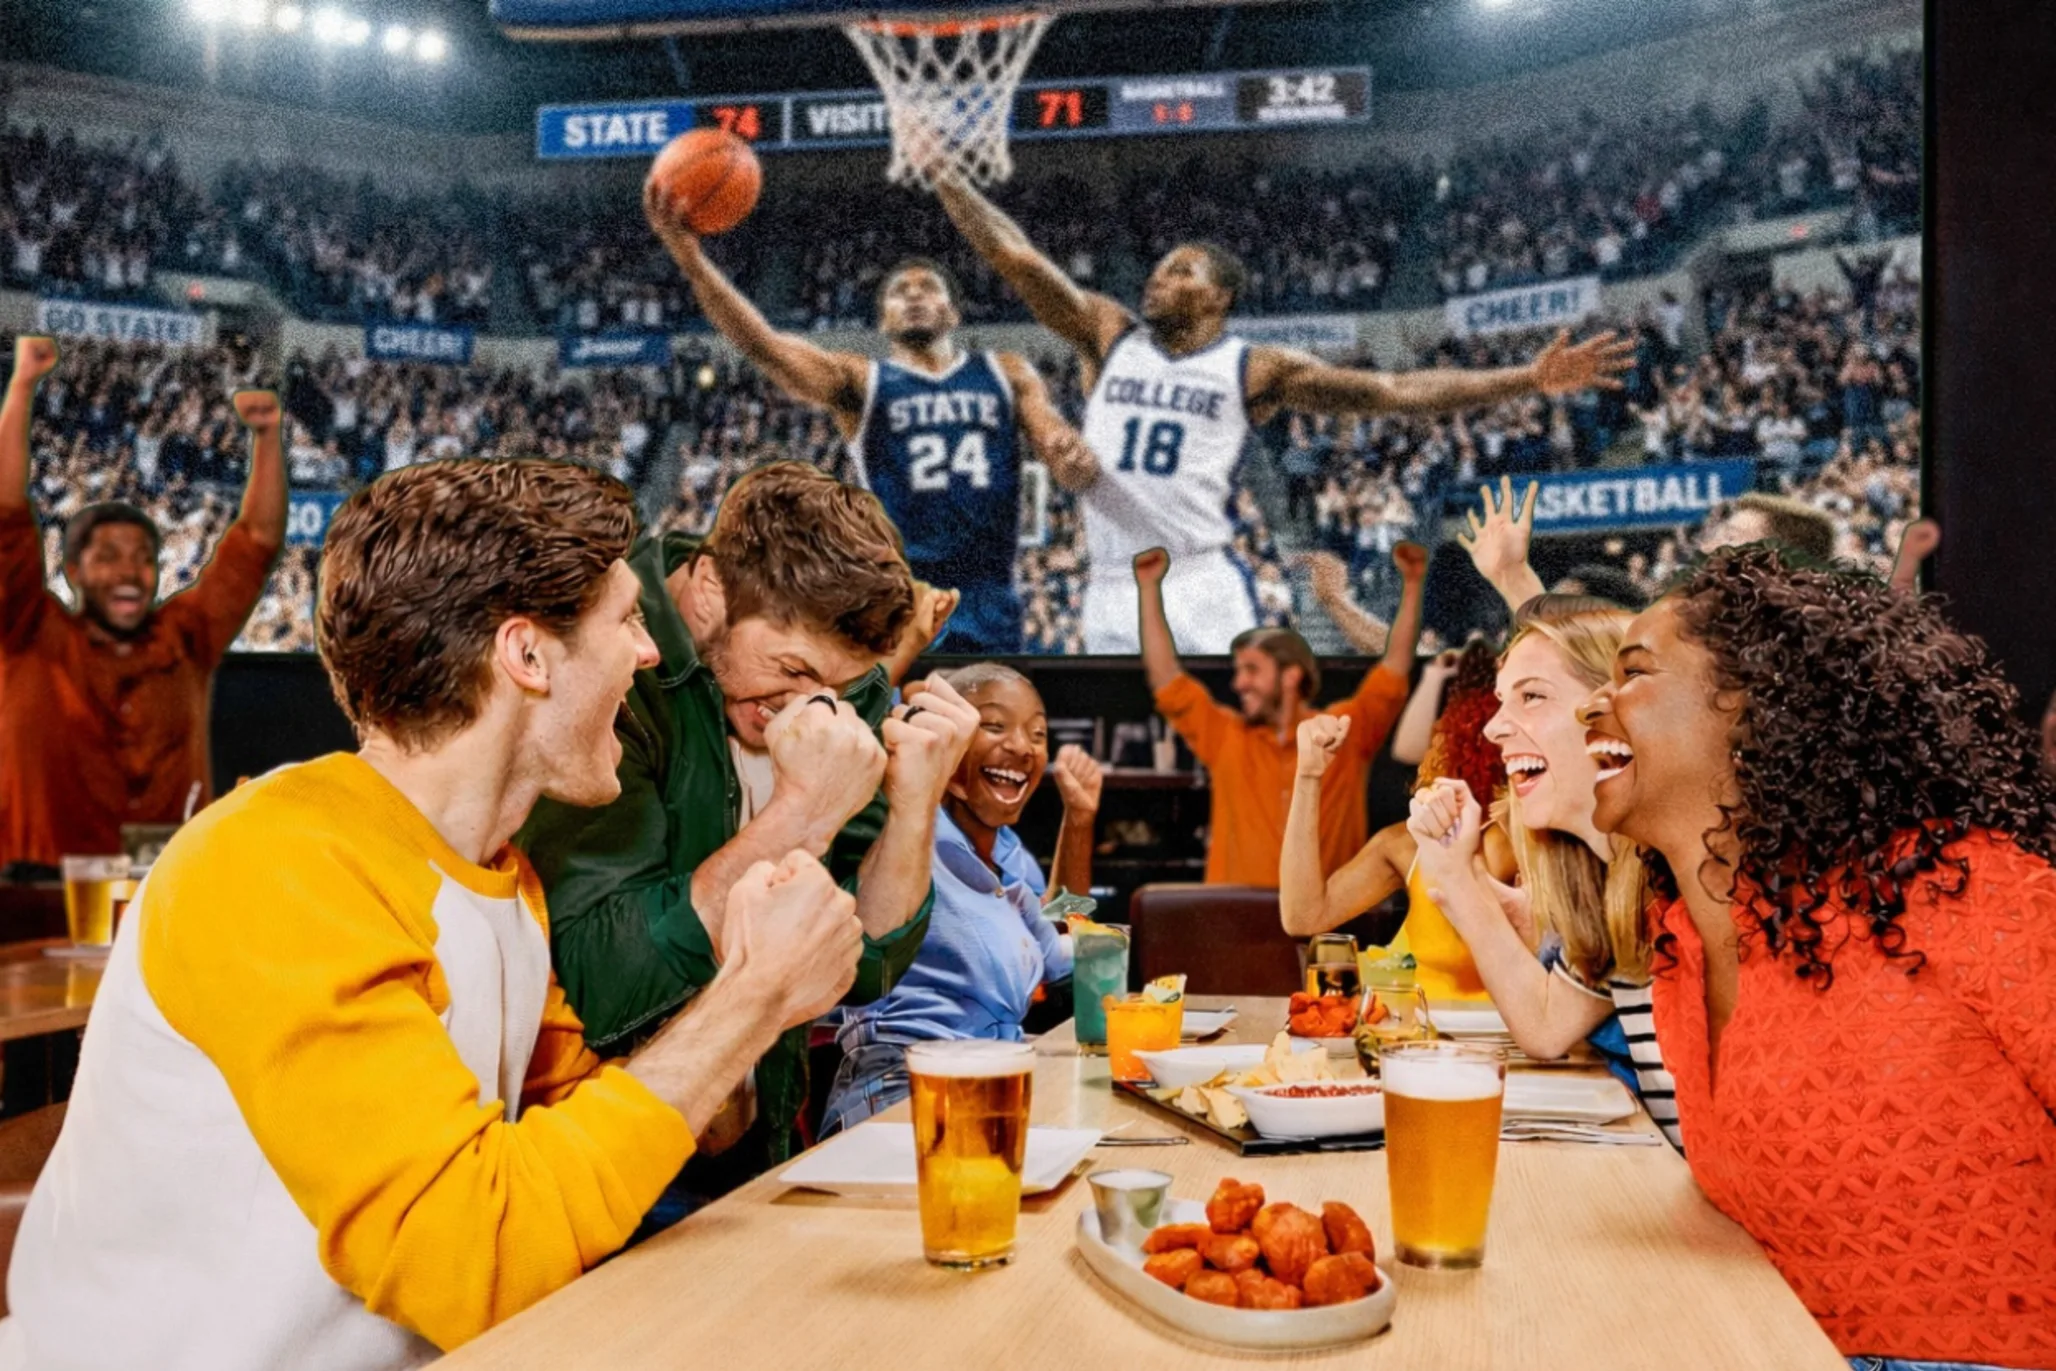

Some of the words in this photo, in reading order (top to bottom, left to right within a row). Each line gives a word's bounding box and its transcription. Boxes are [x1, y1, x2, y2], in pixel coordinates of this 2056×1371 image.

[563, 110, 669, 148] STATE
[1035, 88, 1084, 128] 71
[46, 305, 87, 332] GO
[888, 389, 1000, 433] STATE
[1104, 375, 1228, 420] COLLEGE
[907, 430, 991, 492] 24
[1117, 416, 1186, 477] 18
[1495, 472, 1722, 520] SKETBALL
